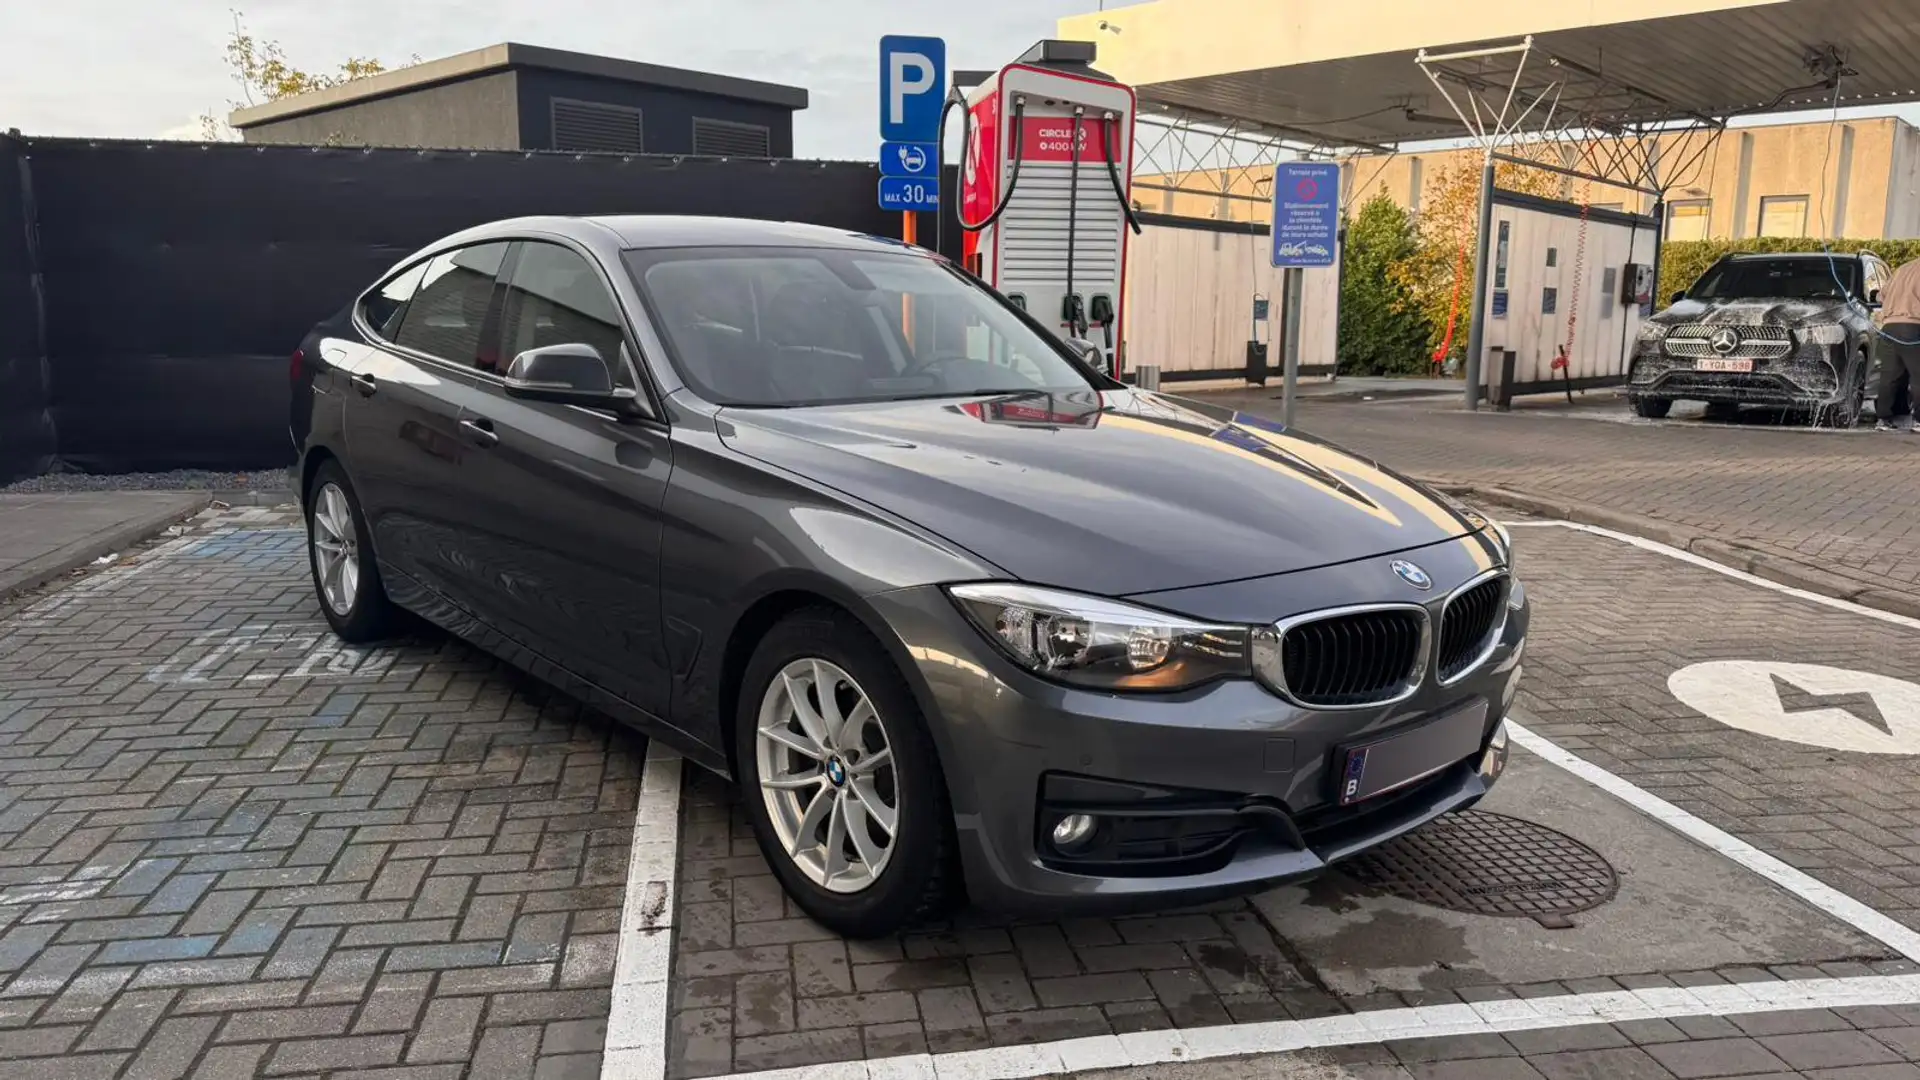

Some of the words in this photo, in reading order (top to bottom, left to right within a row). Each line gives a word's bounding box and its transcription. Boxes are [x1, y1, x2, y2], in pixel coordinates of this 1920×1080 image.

[890, 52, 935, 124] P
[1039, 129, 1072, 138] CIRCLE
[1048, 142, 1069, 151] 400
[884, 193, 900, 202] MAX
[903, 184, 924, 203] 30
[926, 194, 940, 203] MIN
[1346, 779, 1358, 796] B
